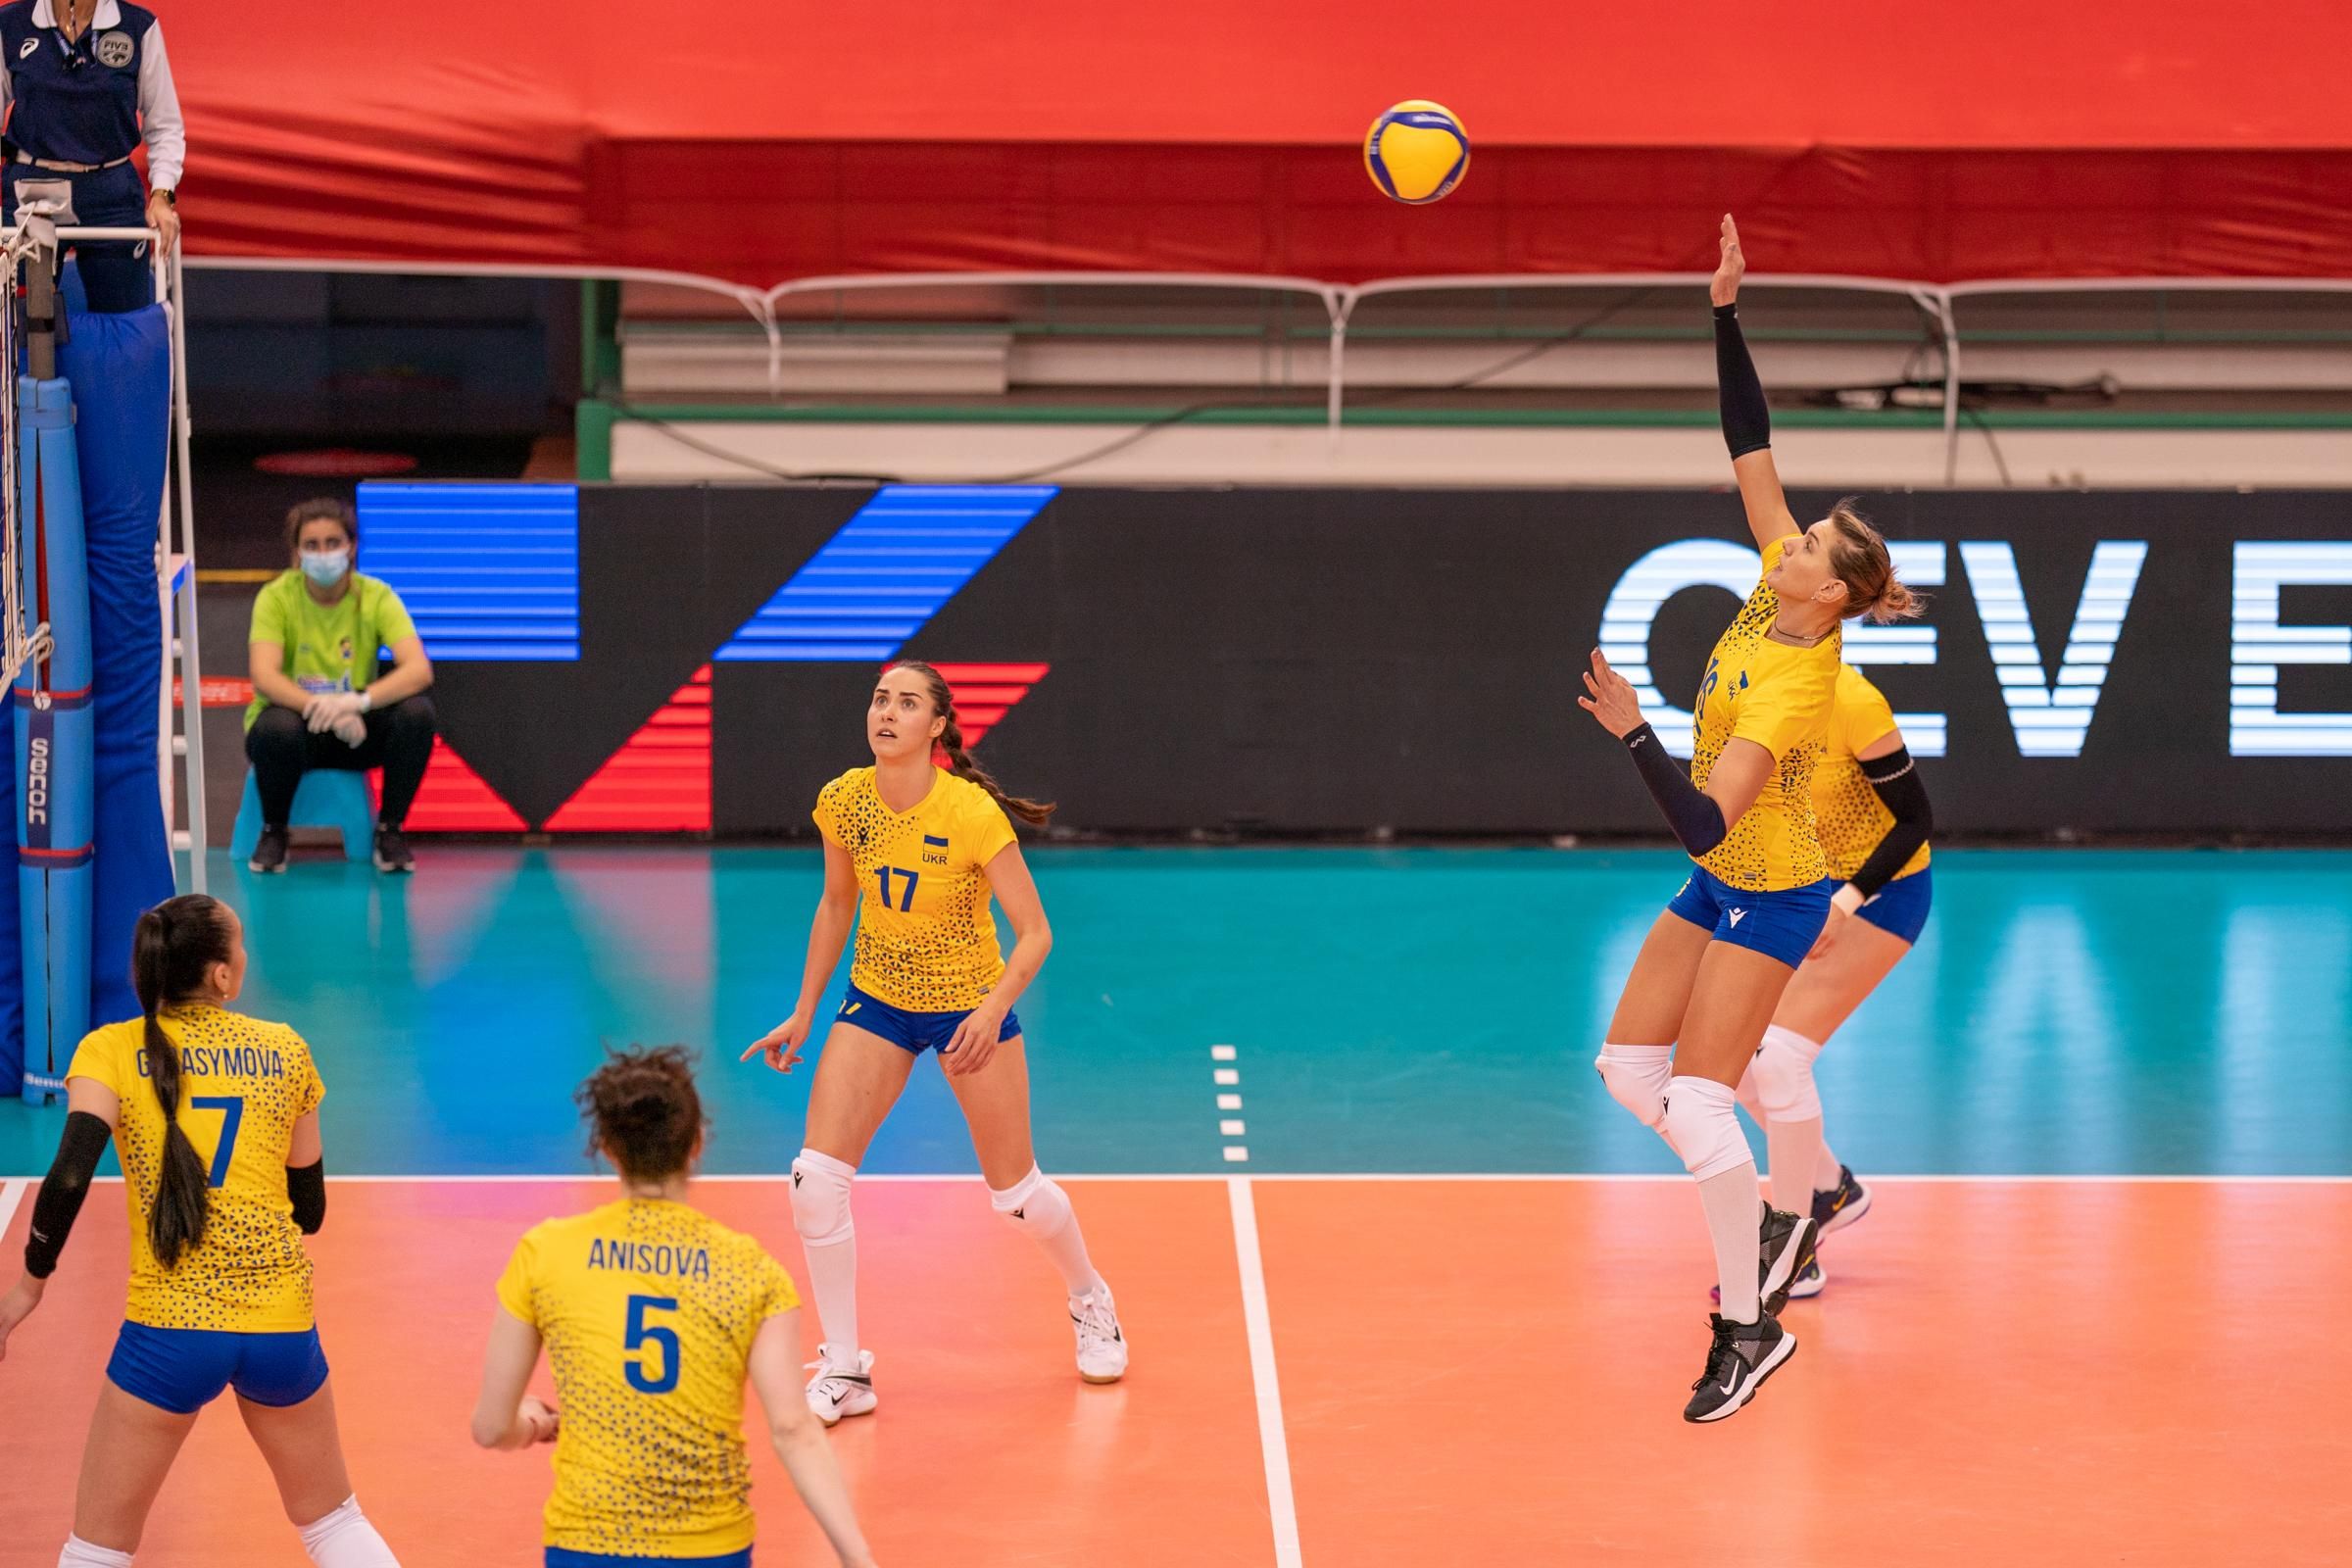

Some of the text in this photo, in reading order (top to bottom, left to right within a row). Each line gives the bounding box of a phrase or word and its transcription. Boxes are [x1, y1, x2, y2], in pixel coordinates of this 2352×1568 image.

[1598, 538, 2148, 759] CEV
[922, 853, 948, 865] UKR
[874, 864, 919, 912] 17
[136, 1047, 283, 1080] GASYMOVA
[191, 1096, 244, 1189] 7
[587, 1237, 710, 1279] ANISOVA
[623, 1294, 680, 1395] 5
